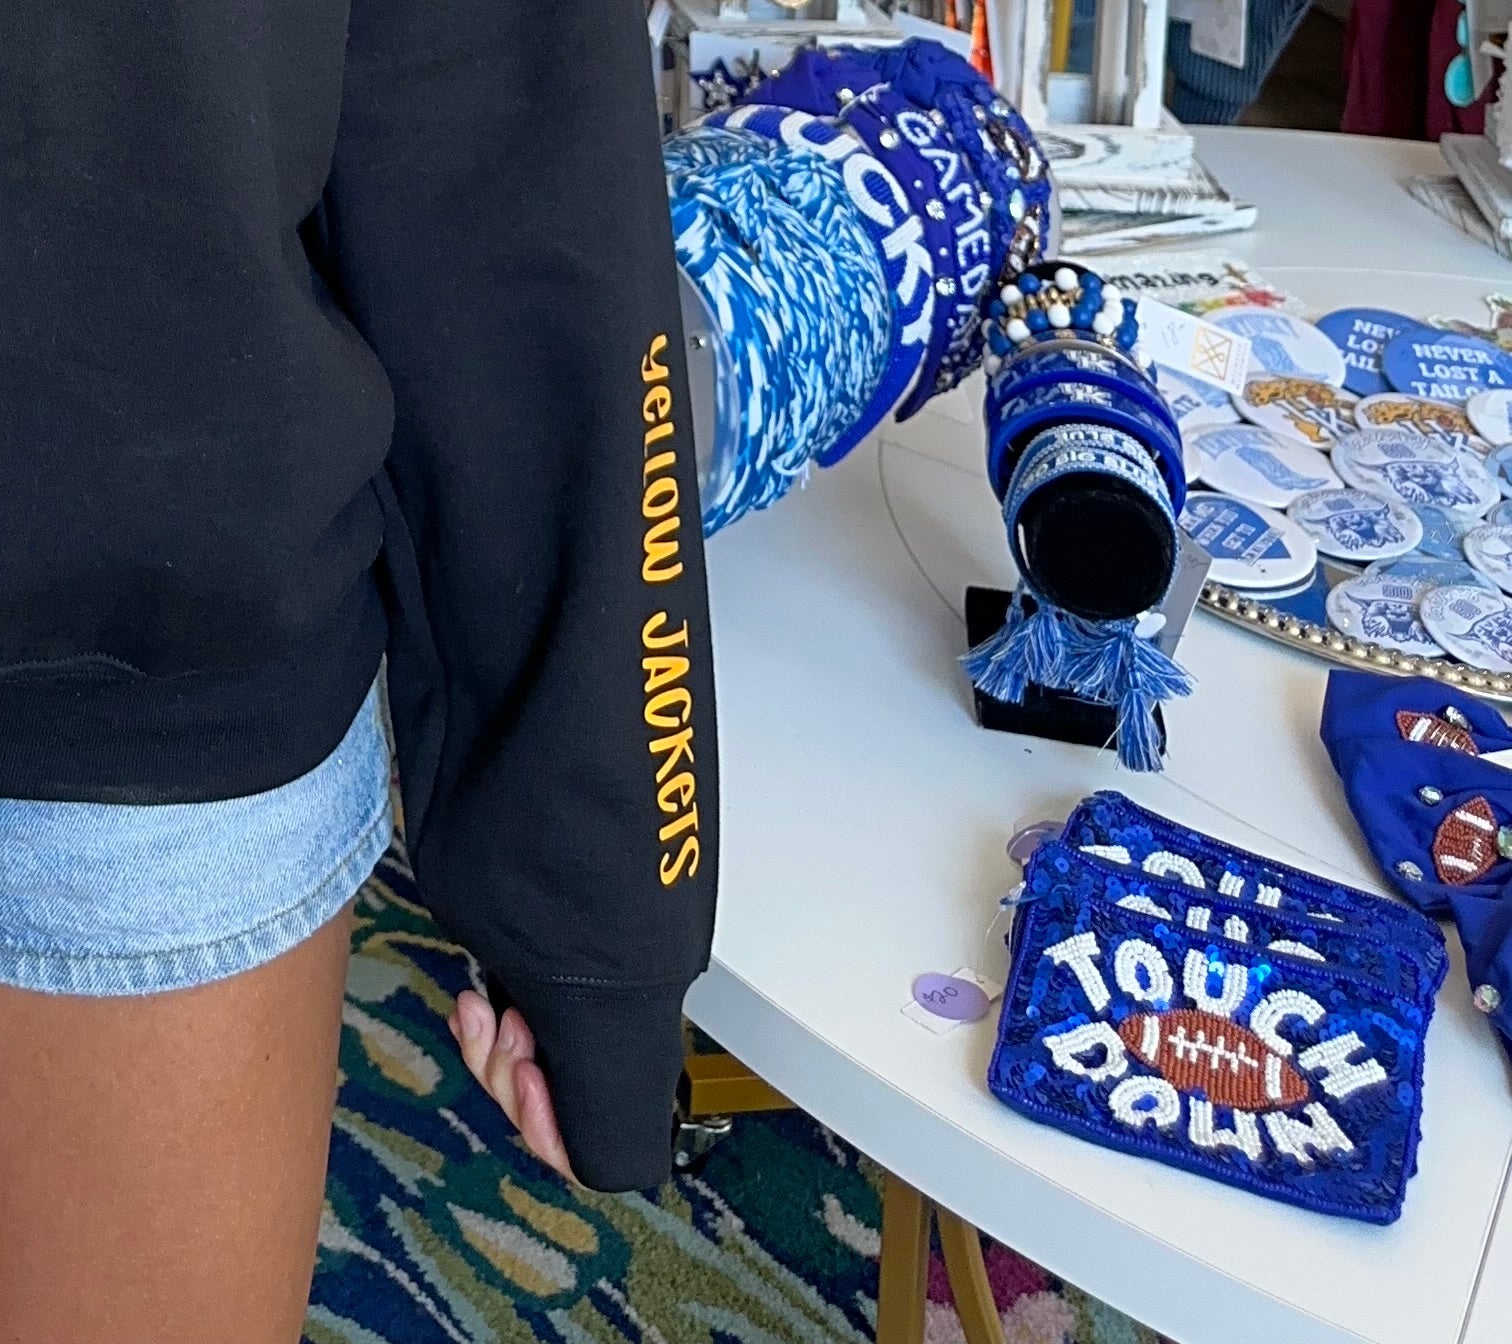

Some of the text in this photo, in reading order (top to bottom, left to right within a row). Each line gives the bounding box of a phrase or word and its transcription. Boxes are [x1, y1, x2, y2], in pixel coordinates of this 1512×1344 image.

[1411, 342, 1494, 365] NEVER
[1418, 362, 1505, 385] LOST A
[1042, 930, 1389, 1100] TOUCH
[1042, 1020, 1358, 1165] DOWN
